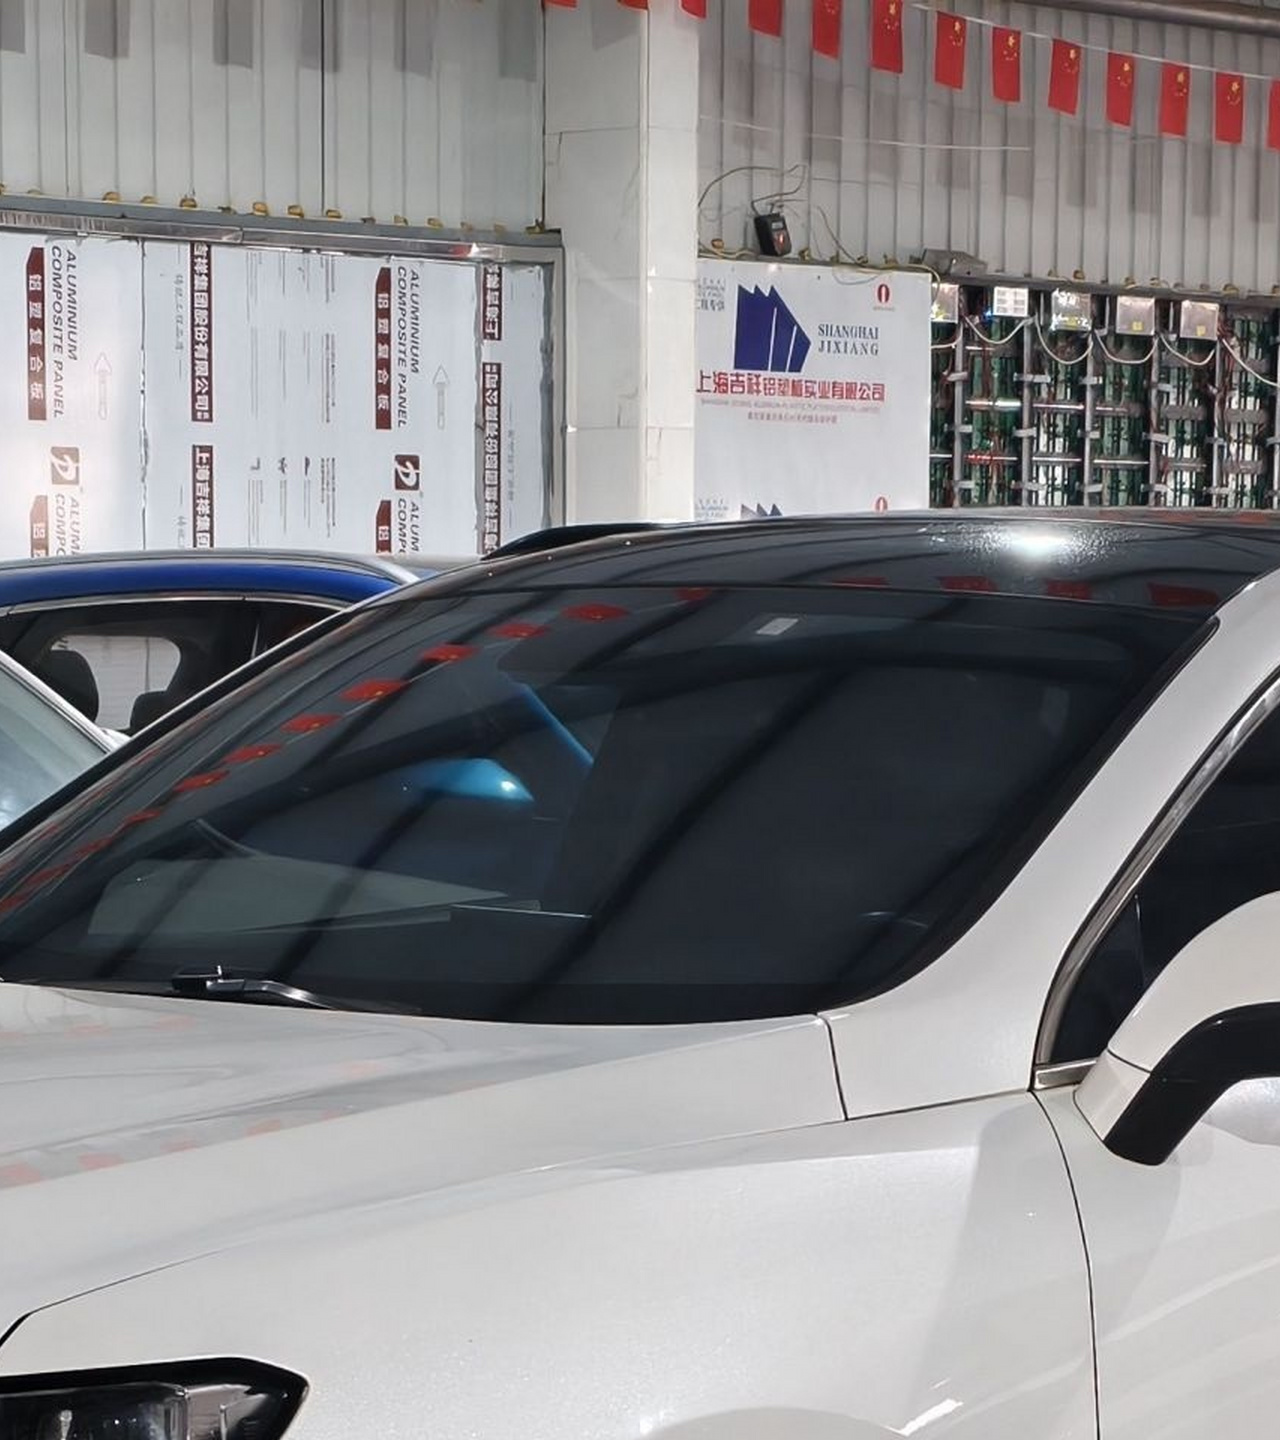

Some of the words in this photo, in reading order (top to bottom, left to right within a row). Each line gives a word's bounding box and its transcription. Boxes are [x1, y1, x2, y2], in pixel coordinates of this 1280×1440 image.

[51, 245, 64, 354] COMPOSITE
[66, 250, 79, 361] ALUMINIUM
[397, 266, 408, 368] COMPOSITE
[408, 269, 420, 373] ALUMINIUM
[818, 323, 879, 340] SHANGHAI
[53, 358, 65, 418] PANEL
[818, 341, 879, 356] JIXIANG
[398, 372, 407, 427] PANEL
